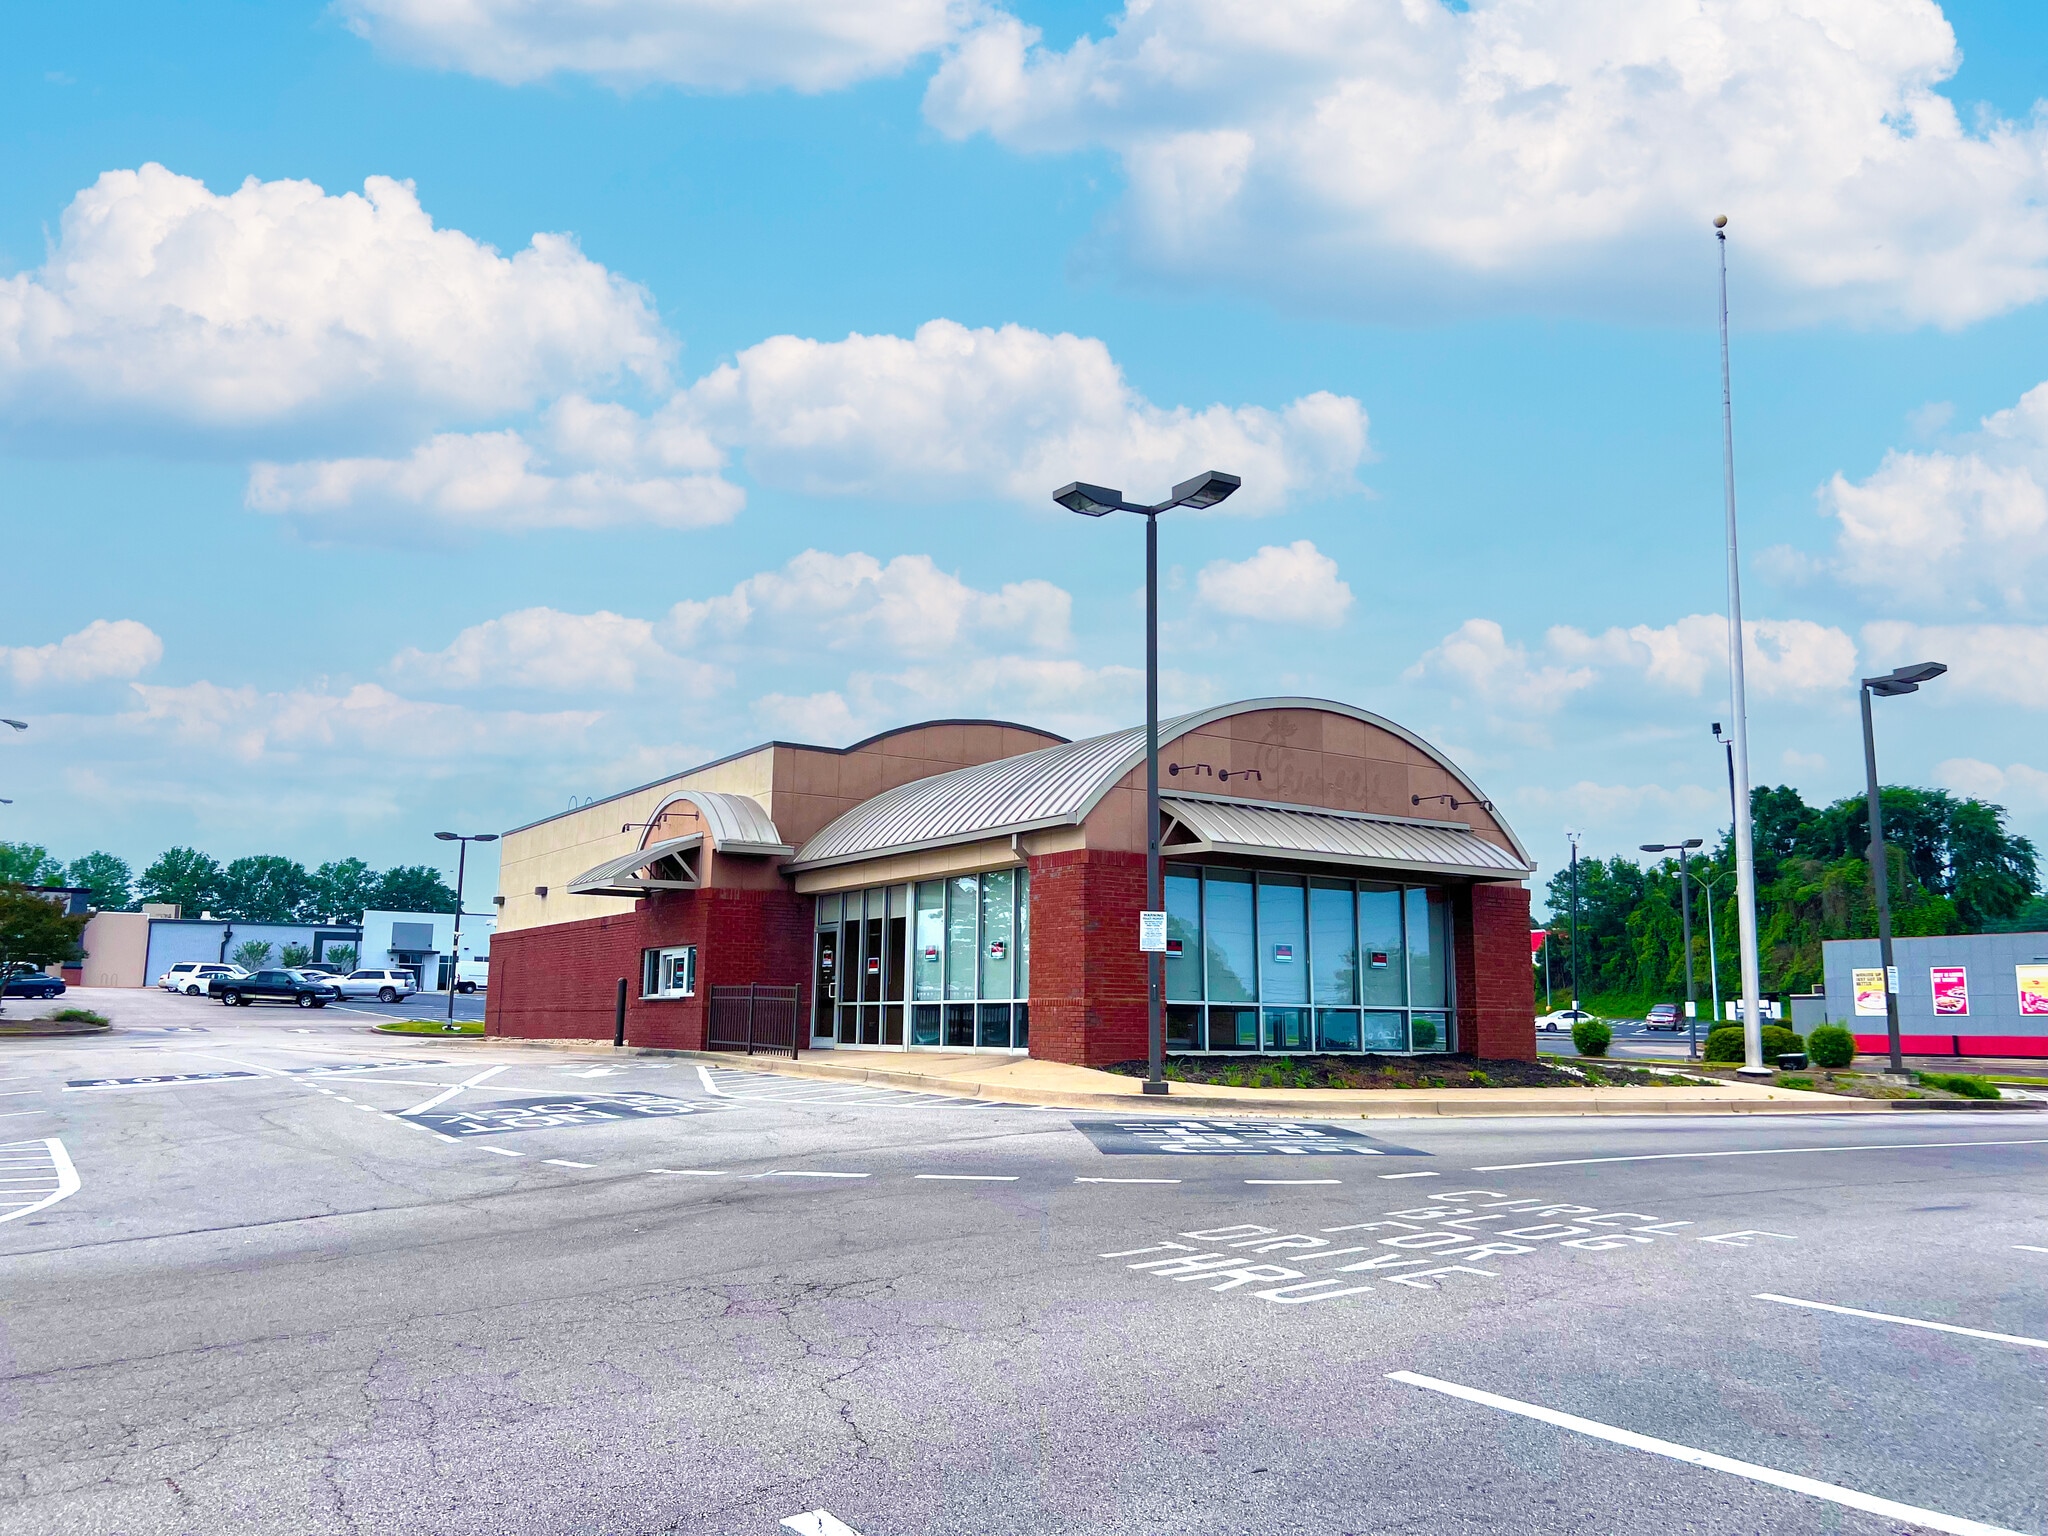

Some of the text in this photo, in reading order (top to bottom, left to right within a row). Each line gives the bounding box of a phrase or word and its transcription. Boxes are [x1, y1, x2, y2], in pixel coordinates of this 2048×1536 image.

[92, 1072, 232, 1087] STOP
[419, 1096, 688, 1124] BLOCK
[459, 1101, 748, 1134] DO NOT
[1384, 1205, 1656, 1251] BLDG
[1427, 1190, 1799, 1248] CIRCLE
[1179, 1223, 1499, 1290] DRIVE
[1321, 1222, 1538, 1261] FOR
[1099, 1240, 1375, 1303] THRU
